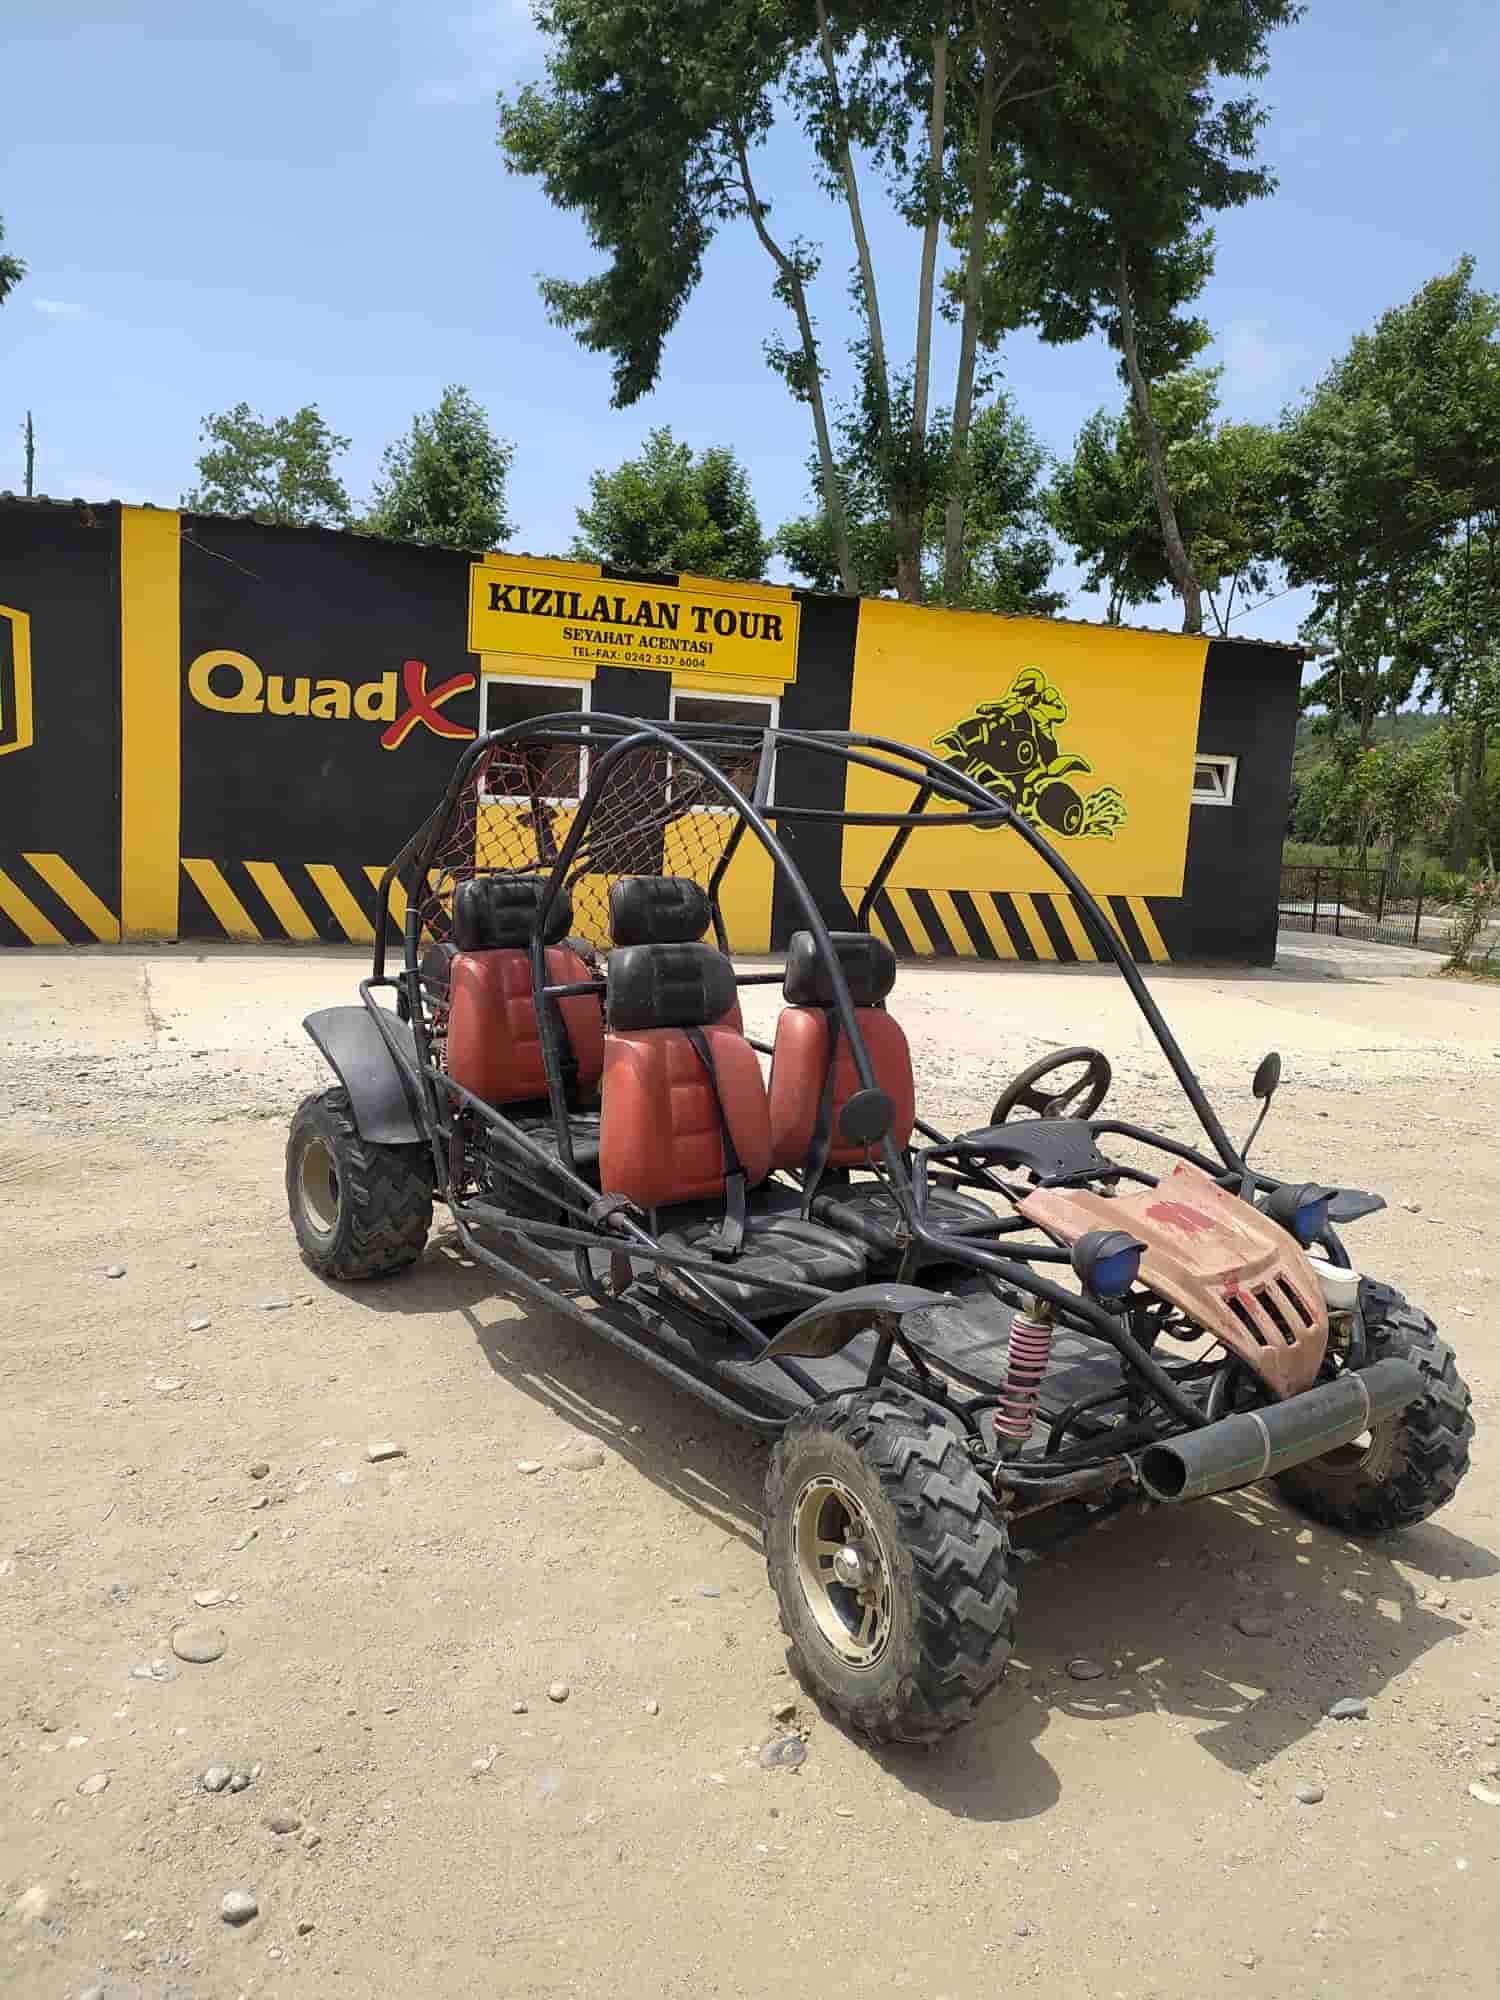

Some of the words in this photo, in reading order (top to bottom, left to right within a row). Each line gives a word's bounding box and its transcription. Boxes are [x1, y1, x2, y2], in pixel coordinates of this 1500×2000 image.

[489, 583, 680, 630] KIZILALAN
[692, 606, 784, 641] TOUR
[563, 627, 634, 647] SEYAHAT
[639, 636, 713, 654] ACENTASI
[624, 652, 652, 664] 0242
[655, 655, 676, 666] 537
[679, 657, 705, 668] 6004
[188, 649, 477, 750] QuadX
